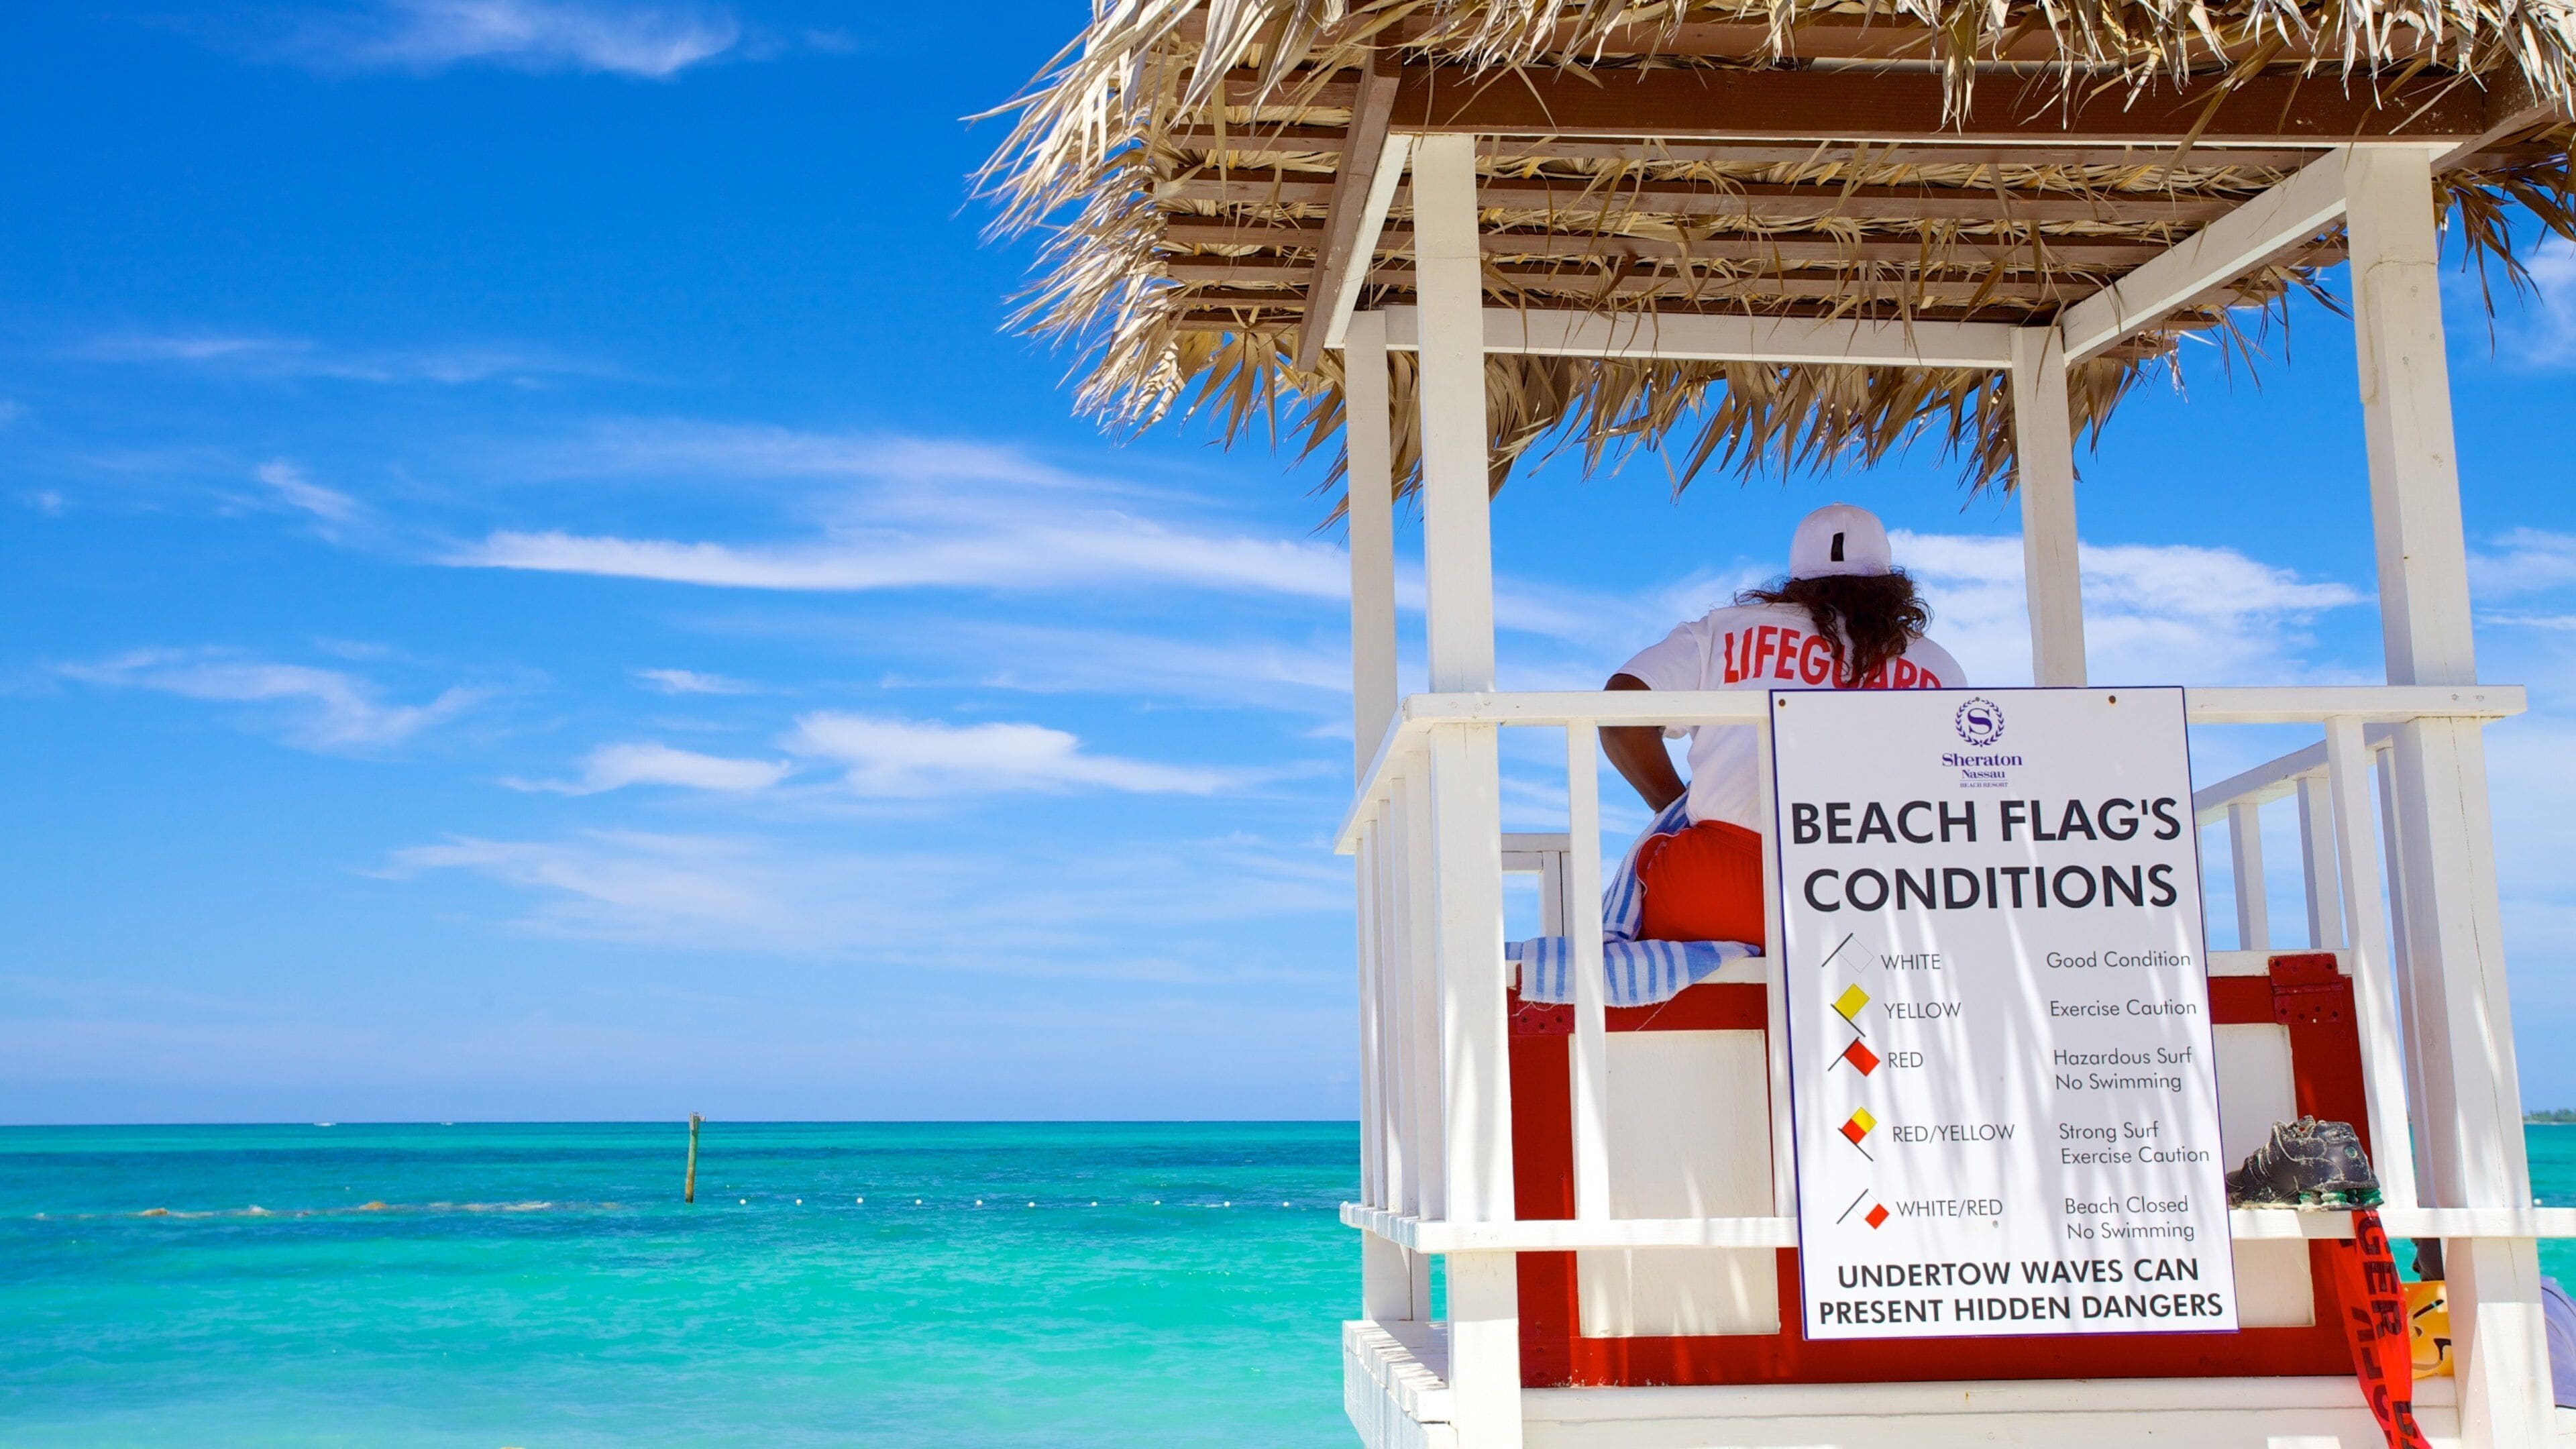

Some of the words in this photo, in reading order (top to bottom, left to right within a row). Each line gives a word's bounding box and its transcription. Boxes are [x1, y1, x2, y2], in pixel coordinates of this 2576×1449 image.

[1968, 708, 1992, 735] S
[1942, 753, 2023, 767] Sheraton
[1962, 769, 2005, 778] Nassau
[1792, 800, 1976, 844] BEACH
[2000, 798, 2180, 841] FLAG'S
[1804, 864, 2177, 912] CONDITIONS
[1881, 954, 1941, 970] WHITE
[2047, 951, 2096, 968] Good
[2104, 950, 2190, 967] Condition
[1884, 1002, 1961, 1019] YELLOW
[2051, 1001, 2119, 1016] Exercise
[2127, 999, 2196, 1015] Caution
[1888, 1052, 1923, 1068] RED
[2054, 1047, 2151, 1066] Hazardous
[2156, 1046, 2192, 1064] Surf
[2056, 1074, 2082, 1089] No
[2090, 1073, 2181, 1092] Swimming
[1893, 1124, 2015, 1143] RED/YELLOW
[2059, 1123, 2116, 1142] Strong
[2124, 1120, 2159, 1138] Surf
[2061, 1147, 2132, 1164] Exercise
[2139, 1146, 2209, 1163] Caution
[1896, 1199, 2002, 1218] WHITE/RED
[2065, 1197, 2119, 1214] Beach
[2127, 1195, 2188, 1213] Closed
[2068, 1223, 2094, 1239] No
[2101, 1222, 2194, 1242] Swimming
[1839, 1262, 2010, 1288] UNDERTOW
[2021, 1259, 2123, 1283] WAVES
[2134, 1258, 2198, 1282] CAN
[1820, 1299, 1943, 1324] PRESENT
[1955, 1297, 2070, 1321] HIDDEN
[2082, 1293, 2222, 1318] DANGERS
